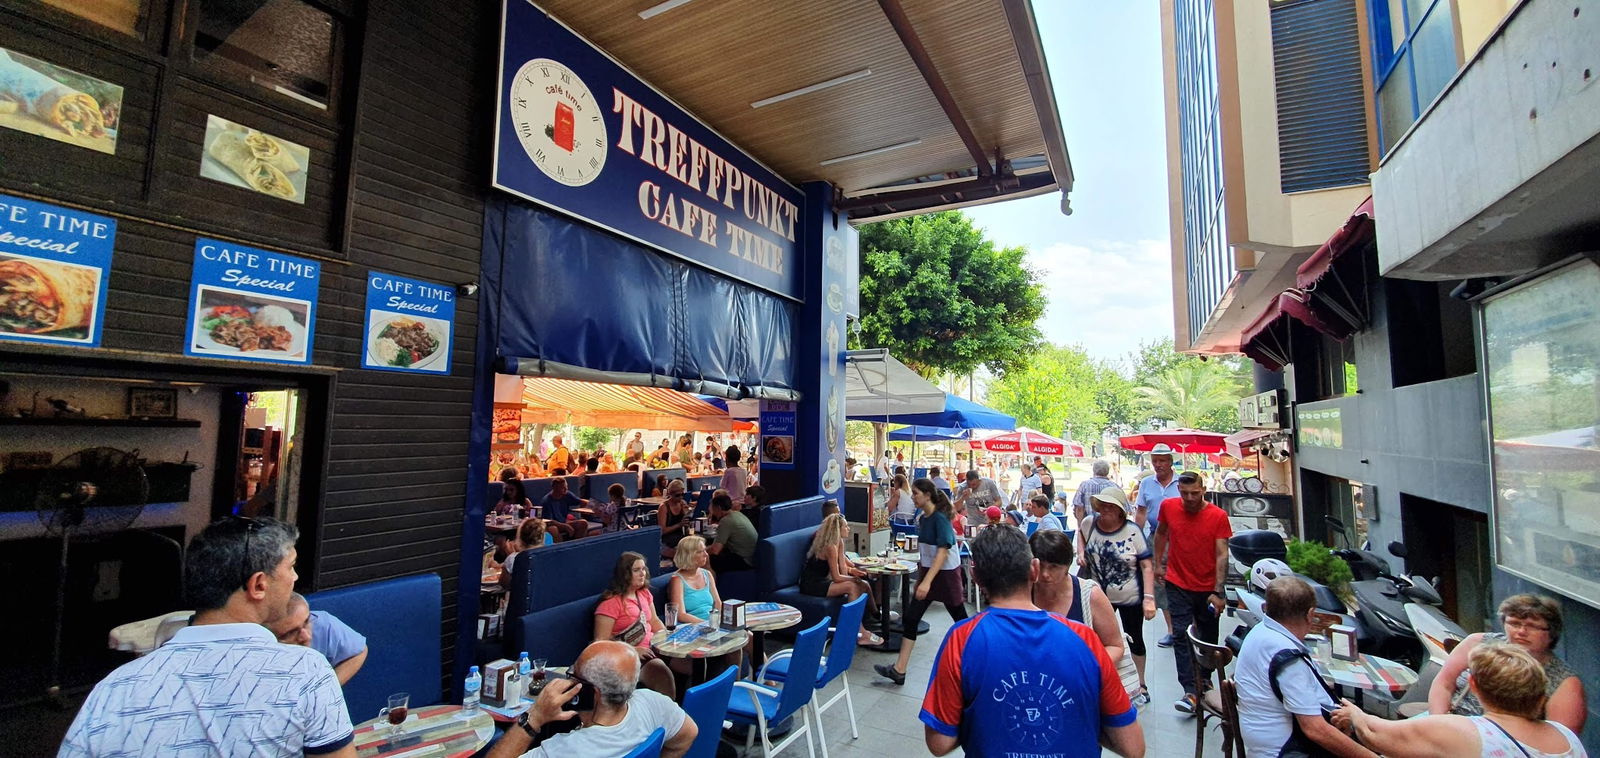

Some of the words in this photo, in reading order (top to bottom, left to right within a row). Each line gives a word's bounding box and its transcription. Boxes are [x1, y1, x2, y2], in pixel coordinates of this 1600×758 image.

[525, 75, 534, 87] X
[541, 67, 550, 78] XI
[561, 72, 570, 85] XII
[565, 90, 582, 111] time
[612, 86, 798, 243] TREFFPUNKT
[39, 211, 108, 239] TIME
[638, 180, 718, 248] CAFE
[725, 220, 784, 276] TIME
[0, 227, 80, 254] pecial
[200, 245, 260, 269] CAFE
[267, 257, 315, 279] TIME
[221, 268, 296, 292] Special
[371, 277, 413, 295] CAFE
[417, 285, 452, 302] TIME
[386, 296, 439, 313] Special
[1034, 446, 1058, 454] ALGIDA
[992, 670, 1029, 702] CAFE
[1040, 672, 1075, 709] TIME
